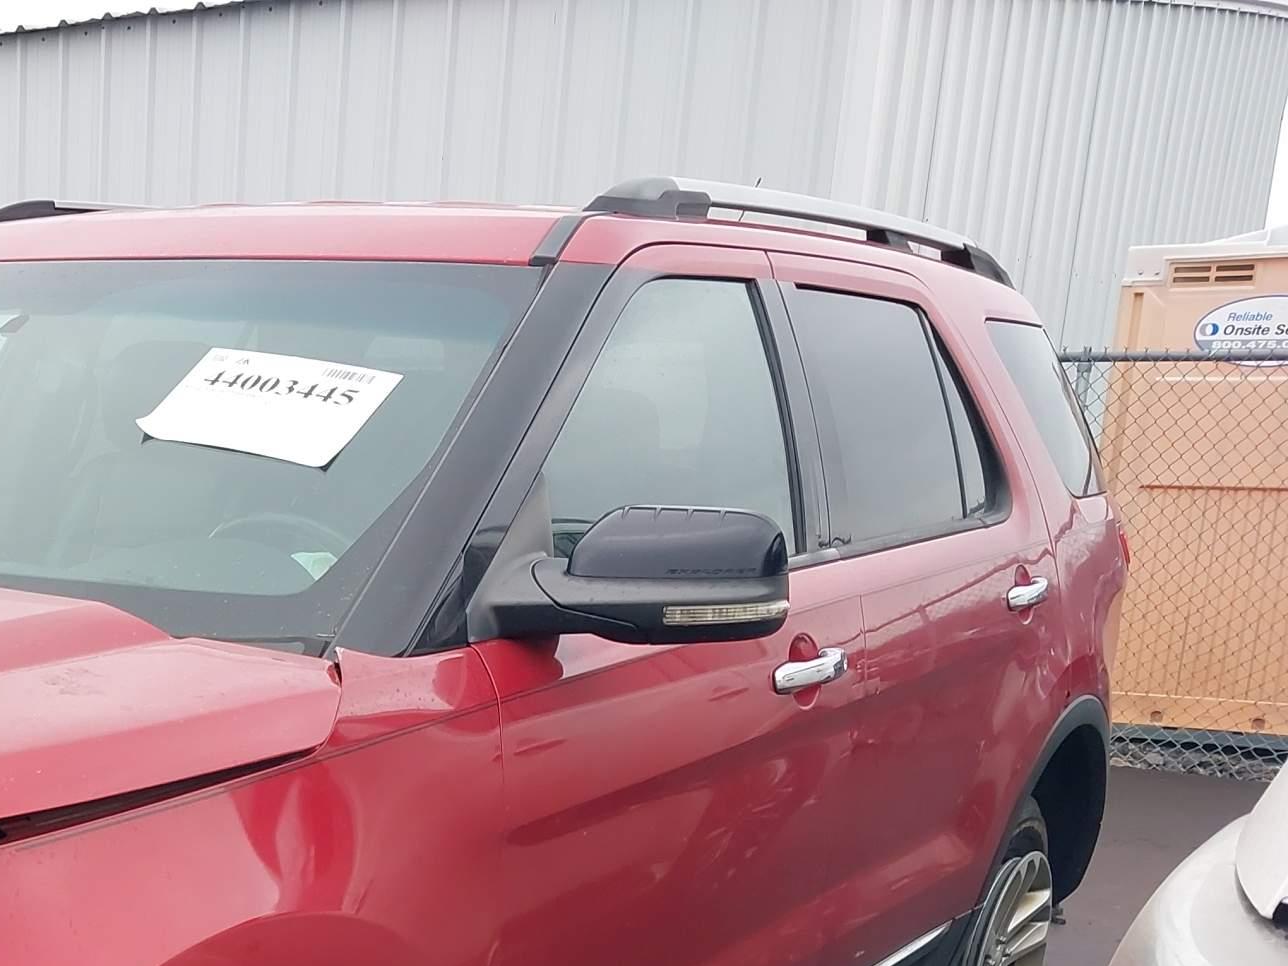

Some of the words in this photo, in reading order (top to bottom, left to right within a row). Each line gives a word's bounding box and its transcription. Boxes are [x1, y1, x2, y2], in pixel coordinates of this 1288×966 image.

[1226, 312, 1273, 321] Reliable
[1223, 324, 1271, 336] Onsite
[203, 370, 360, 405] 44003445
